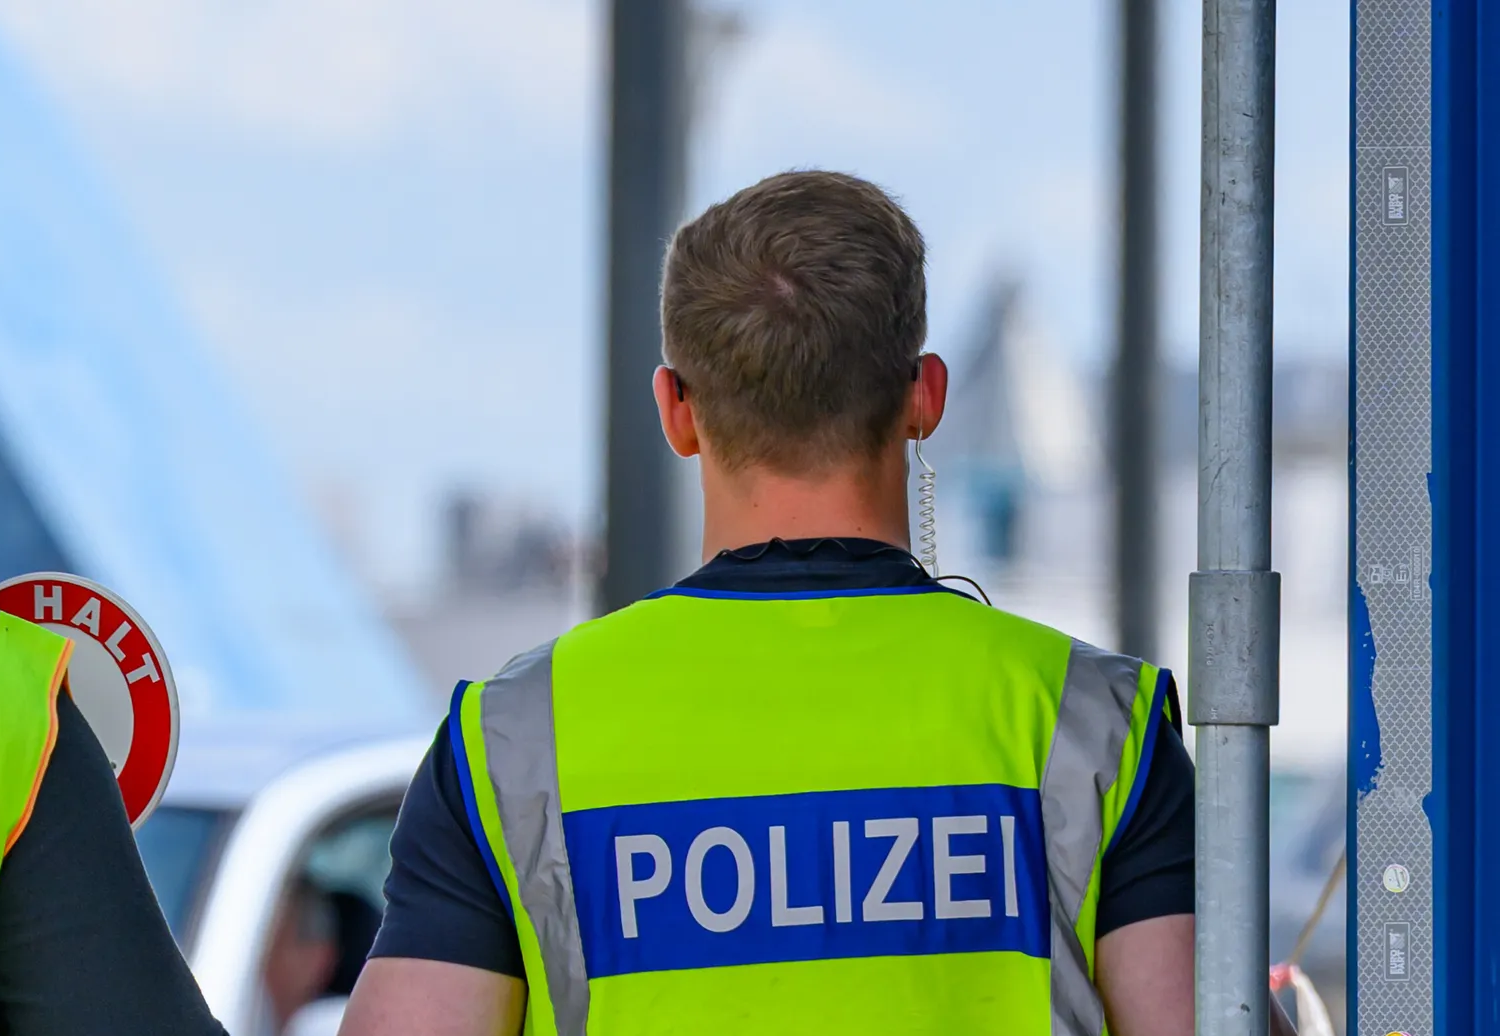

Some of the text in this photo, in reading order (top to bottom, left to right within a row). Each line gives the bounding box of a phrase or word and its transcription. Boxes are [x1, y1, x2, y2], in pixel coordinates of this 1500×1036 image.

[1388, 193, 1396, 219] EURO
[1396, 194, 1404, 219] PART
[34, 584, 160, 685] HALT
[614, 815, 1019, 939] POLIZEI
[1397, 950, 1405, 975] PART
